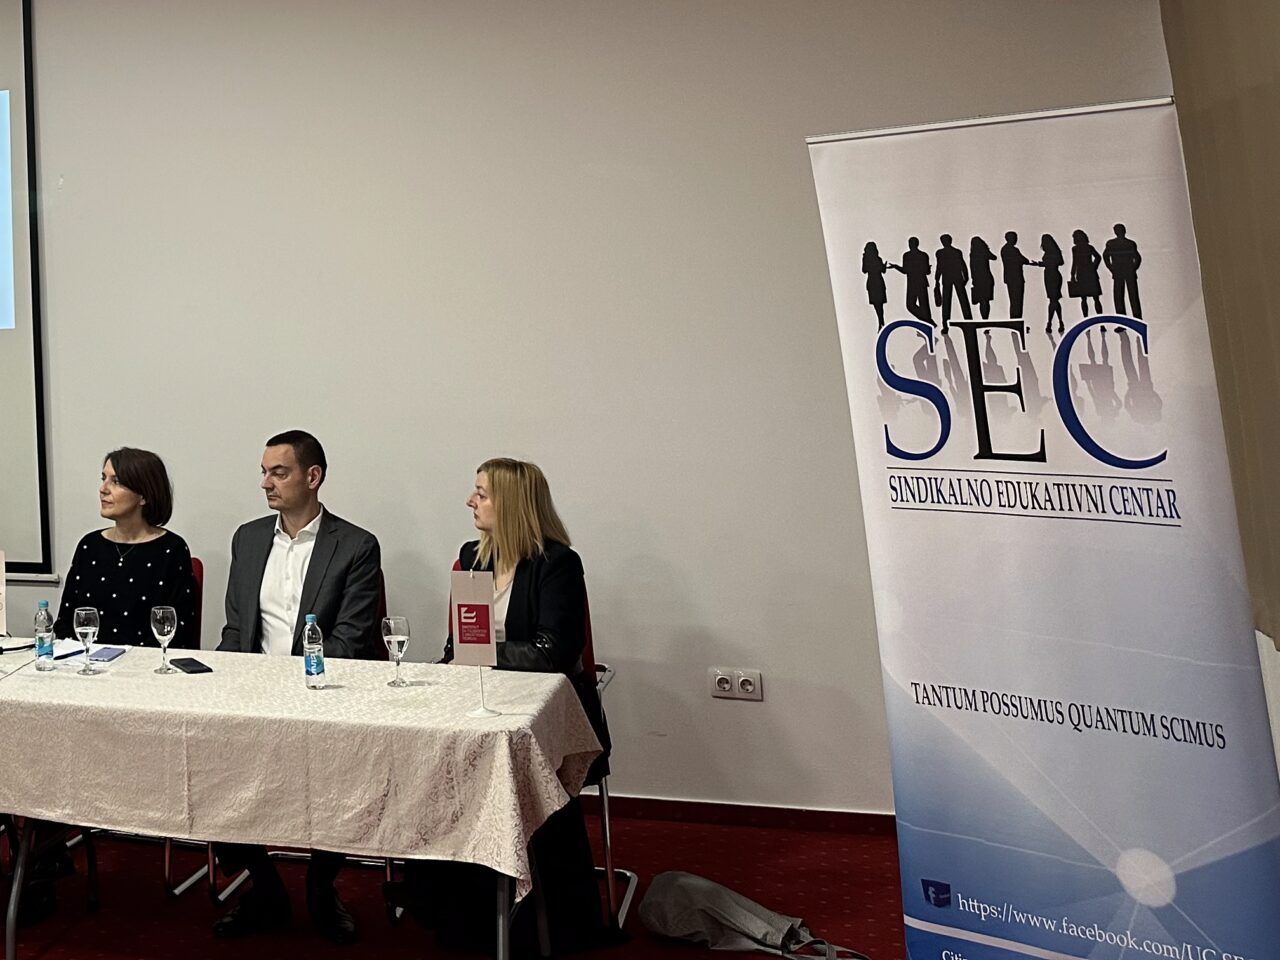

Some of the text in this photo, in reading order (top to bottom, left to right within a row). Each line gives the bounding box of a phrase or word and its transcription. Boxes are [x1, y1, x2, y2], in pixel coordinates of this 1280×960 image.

[874, 314, 1170, 470] SEC
[888, 475, 1182, 520] SINDIKALNO EDUKATIVNI CENTAR
[910, 681, 1227, 750] TANTUM POSSUMUS QUANTUM SCIMUS
